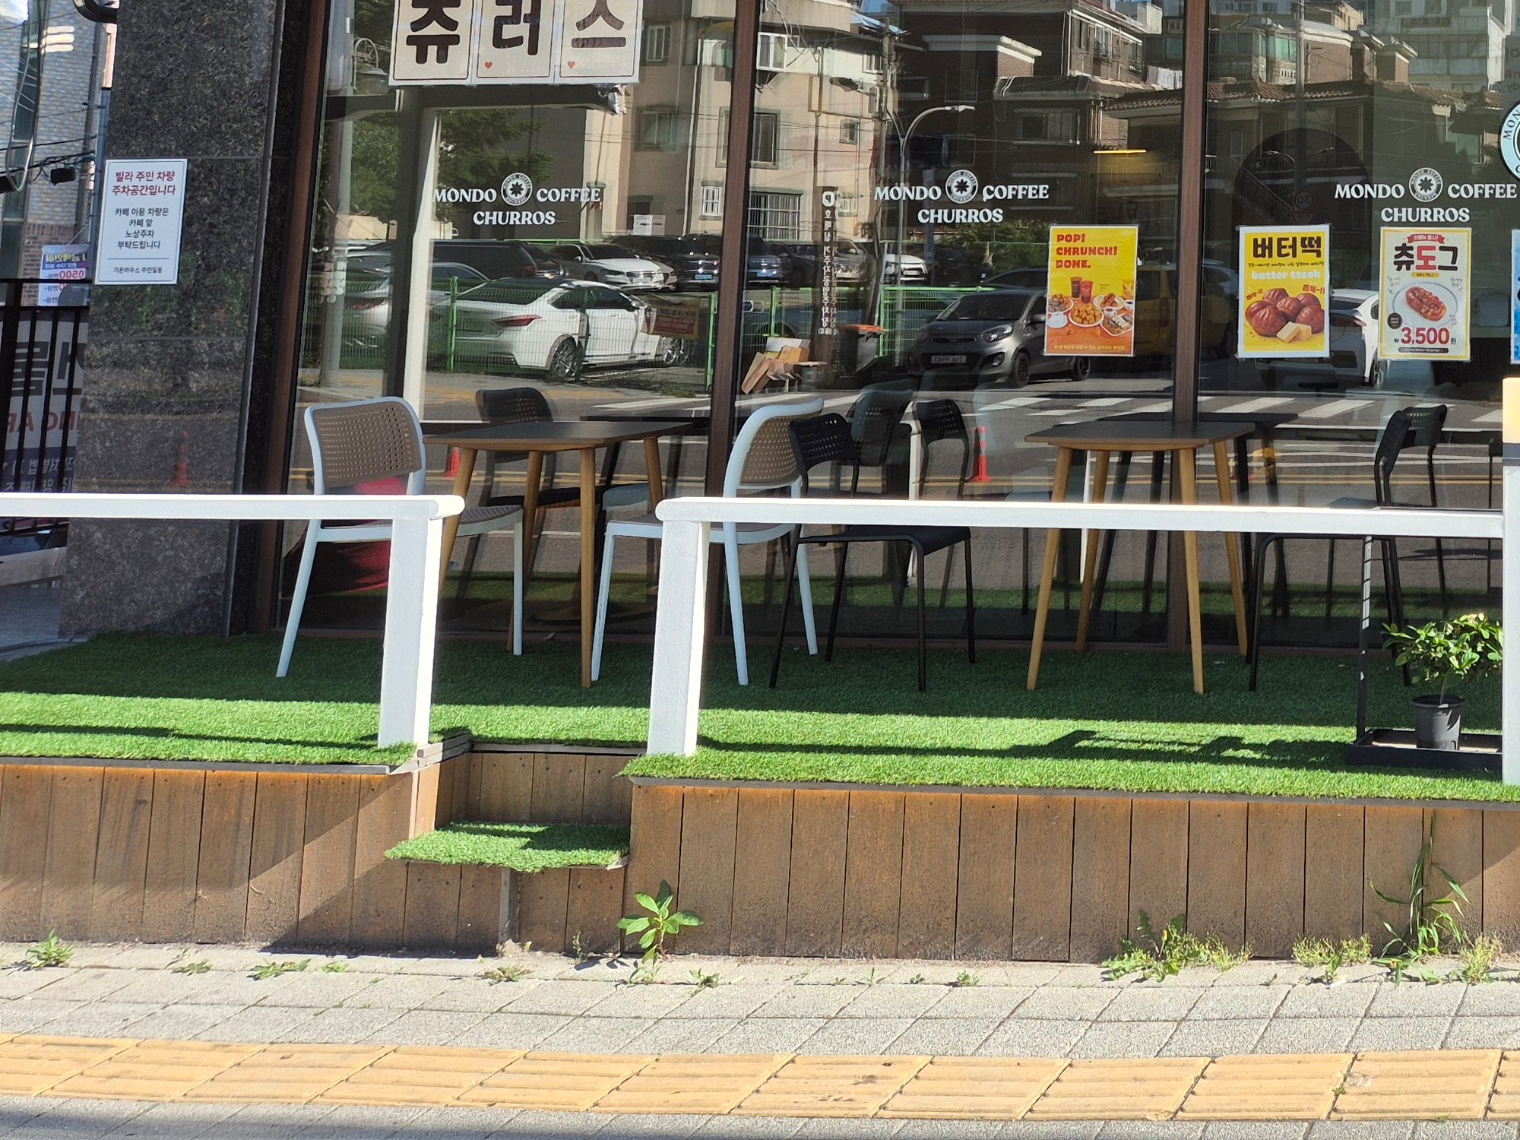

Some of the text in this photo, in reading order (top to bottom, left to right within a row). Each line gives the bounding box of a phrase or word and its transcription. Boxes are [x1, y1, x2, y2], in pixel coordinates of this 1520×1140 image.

[116, 170, 175, 182] 빌라 주민 차량
[112, 185, 176, 196] 주차공간입니다
[432, 188, 497, 203] MONDO
[536, 188, 601, 203] COFFEE
[874, 185, 941, 201] MONDO
[982, 184, 1049, 202] COFFEE
[1334, 184, 1405, 199] MONDO
[1447, 183, 1518, 199] COFFEE
[473, 211, 556, 226] CHURROS
[917, 208, 1003, 224] CHURROS
[1381, 207, 1470, 222] CHURROS
[1056, 233, 1086, 243] POP!
[1056, 246, 1118, 256] CHRUNCH!
[1252, 236, 1321, 258] 버터떡
[1055, 260, 1091, 268] DONE.
[1393, 243, 1458, 271] 츄도그
